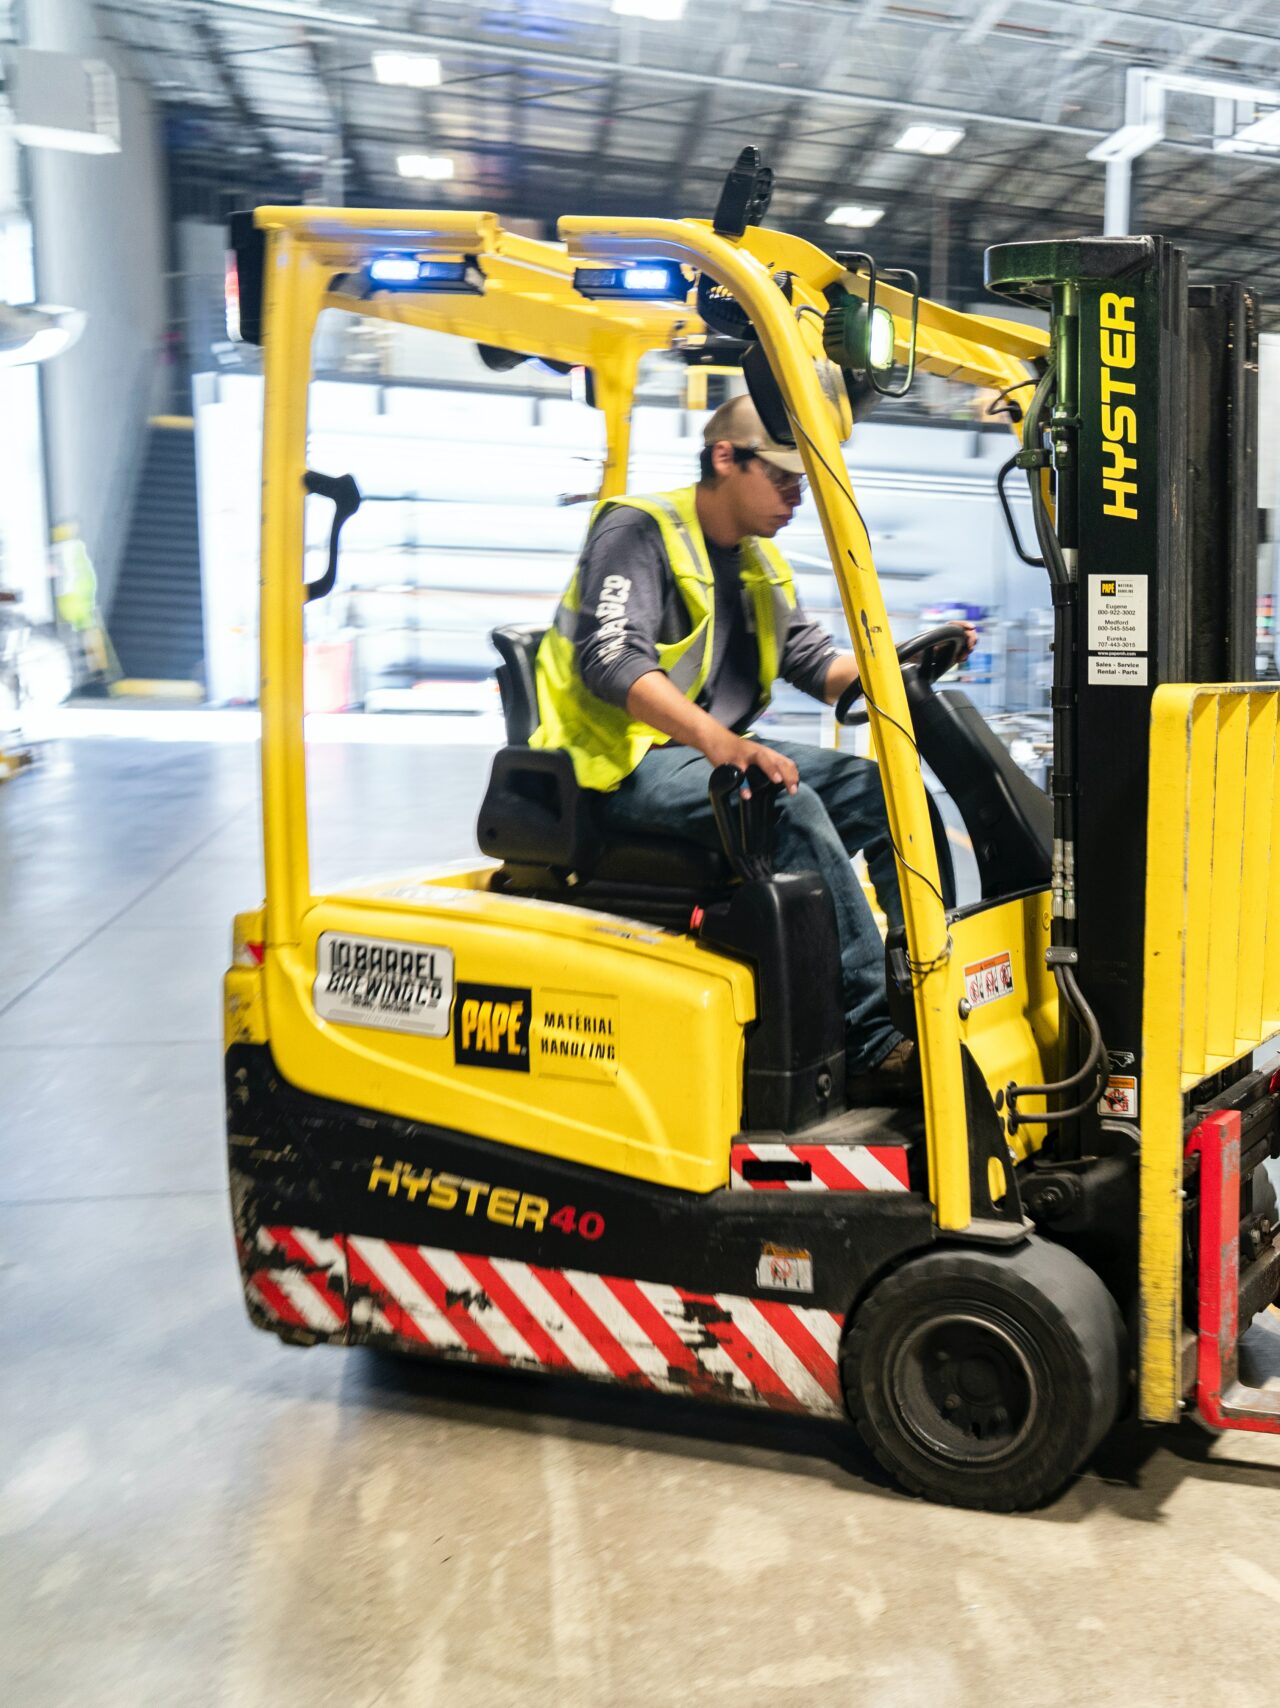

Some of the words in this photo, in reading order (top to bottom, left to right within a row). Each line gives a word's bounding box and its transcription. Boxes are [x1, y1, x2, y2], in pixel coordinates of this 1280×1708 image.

[1099, 292, 1138, 520] HYSTER
[353, 942, 442, 983] BARREL
[543, 1011, 615, 1036] MATERIAL
[540, 1037, 616, 1061] HANDLING
[367, 1154, 550, 1234] HYSTER
[550, 1205, 605, 1242] 40
